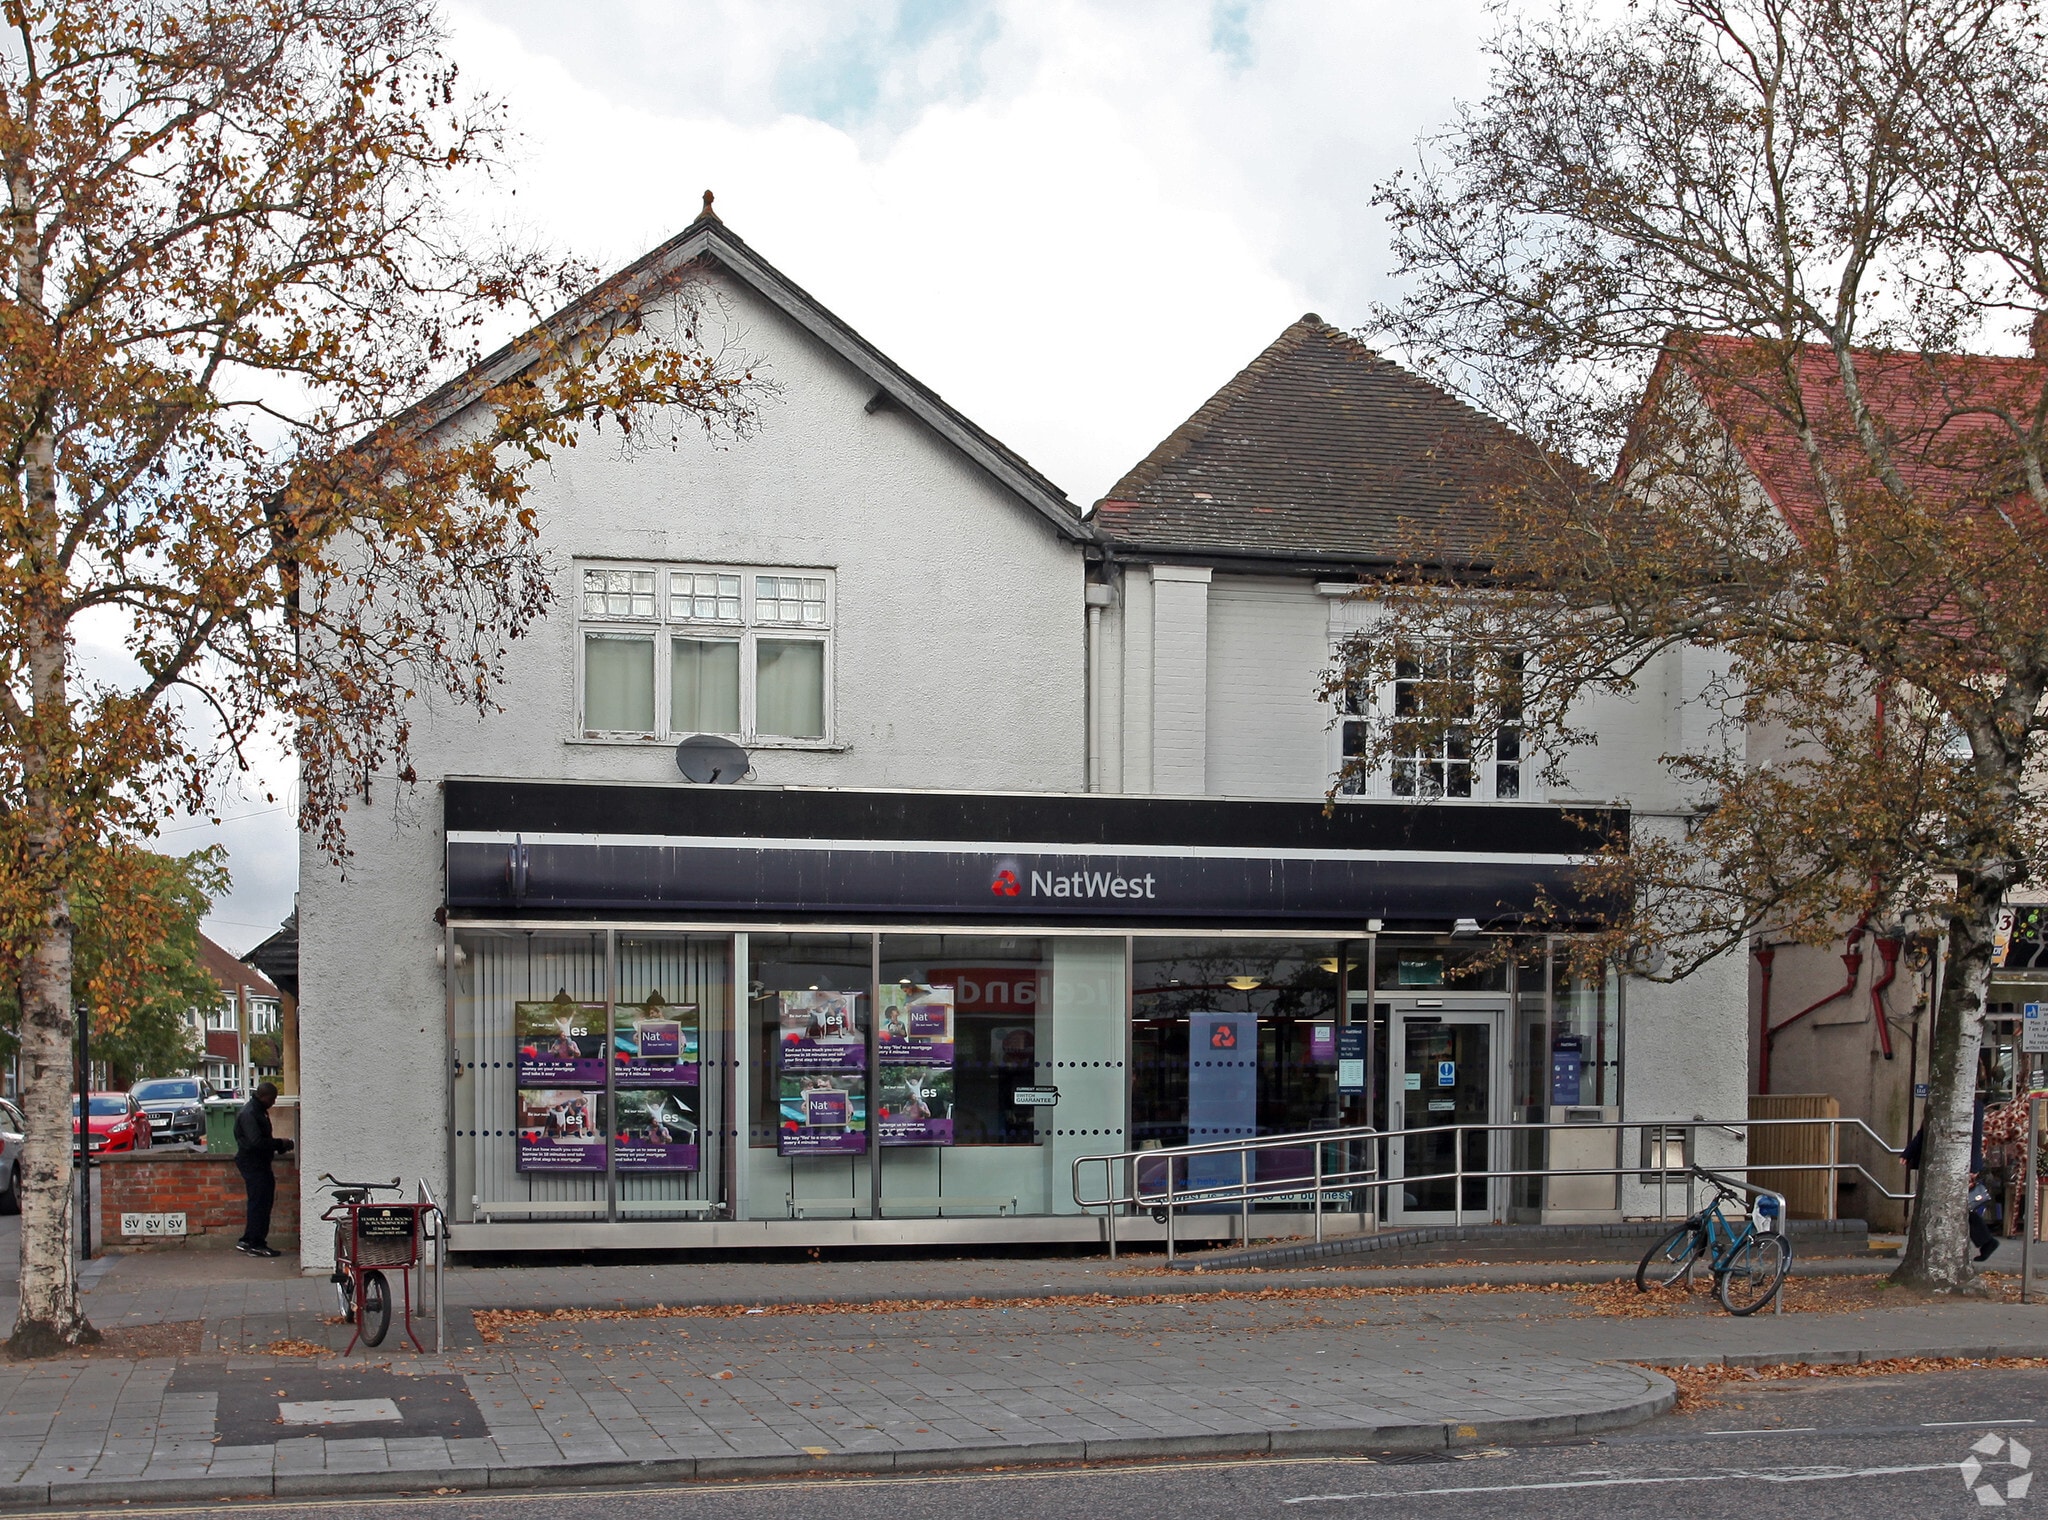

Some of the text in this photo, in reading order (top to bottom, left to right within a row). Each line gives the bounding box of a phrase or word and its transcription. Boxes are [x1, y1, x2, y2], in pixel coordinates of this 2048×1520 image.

[1031, 870, 1156, 898] NatWest
[1300, 1191, 1352, 1200] buiness
[124, 1220, 140, 1228] SV
[146, 1220, 160, 1228] SV
[168, 1220, 182, 1228] SV
